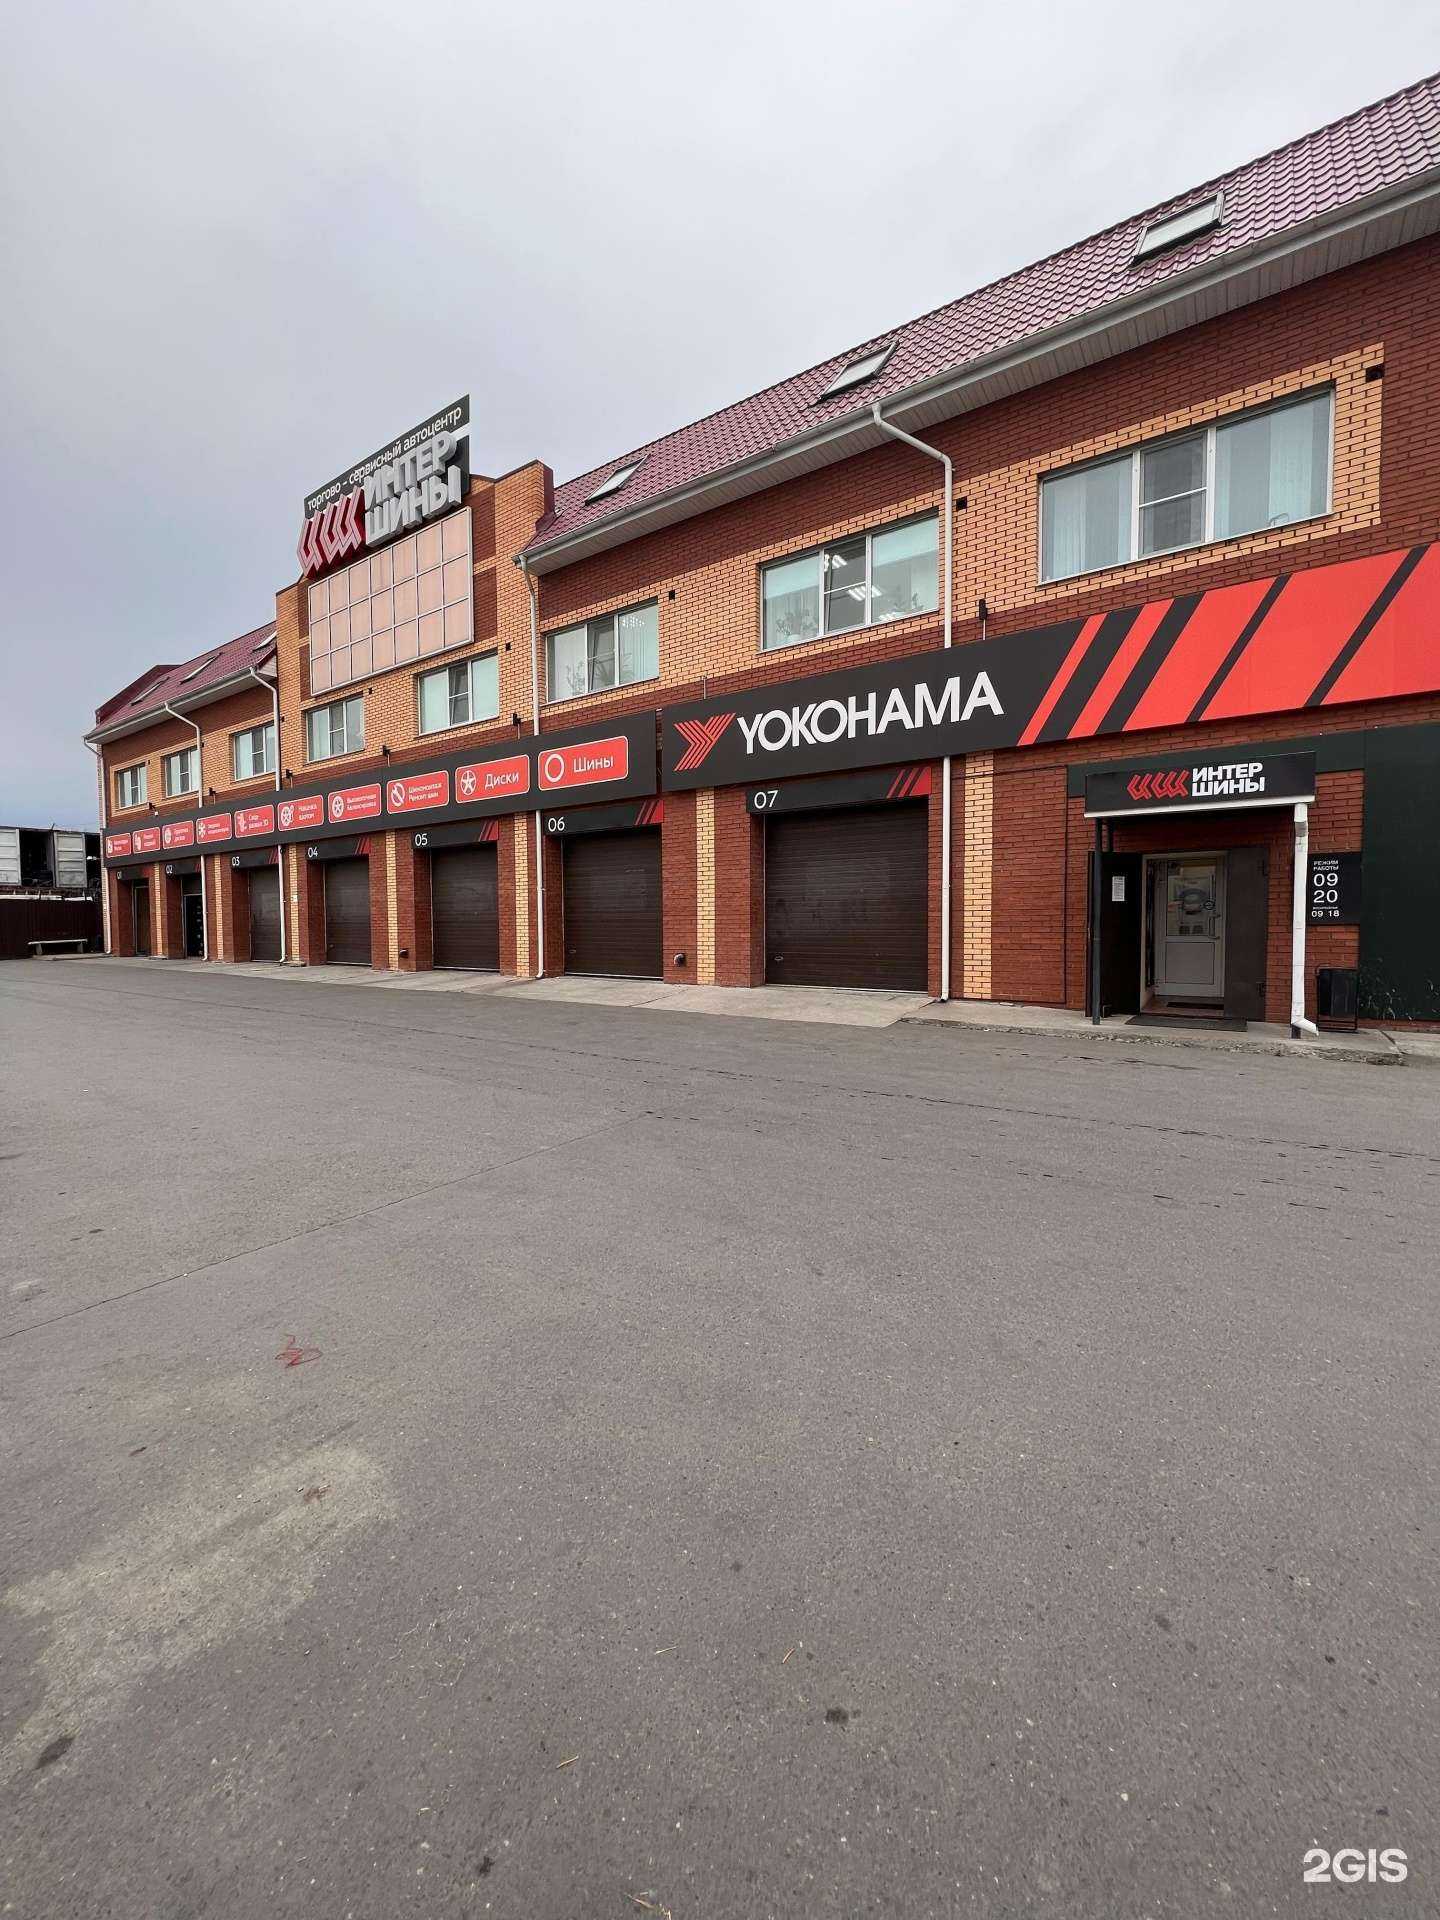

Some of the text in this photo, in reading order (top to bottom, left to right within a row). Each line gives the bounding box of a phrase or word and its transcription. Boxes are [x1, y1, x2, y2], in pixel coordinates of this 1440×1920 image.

[307, 482, 341, 510] торгово
[349, 439, 402, 485] сервисный
[403, 406, 462, 451] автоцентр
[363, 430, 457, 512] ИНТЕР
[365, 465, 462, 547] ШИНЫ
[737, 671, 1005, 754] YOKOHAMA
[573, 756, 614, 773] Шины
[1191, 762, 1263, 783] ИНТЕР
[485, 771, 519, 789] Диски
[1191, 776, 1266, 798] ШИНЫ
[754, 790, 779, 809] 07
[548, 816, 565, 832] 06
[414, 833, 428, 847] 05
[231, 856, 240, 866] 03
[307, 846, 318, 858] 04
[1313, 873, 1338, 887] 09
[1313, 889, 1338, 903] 20
